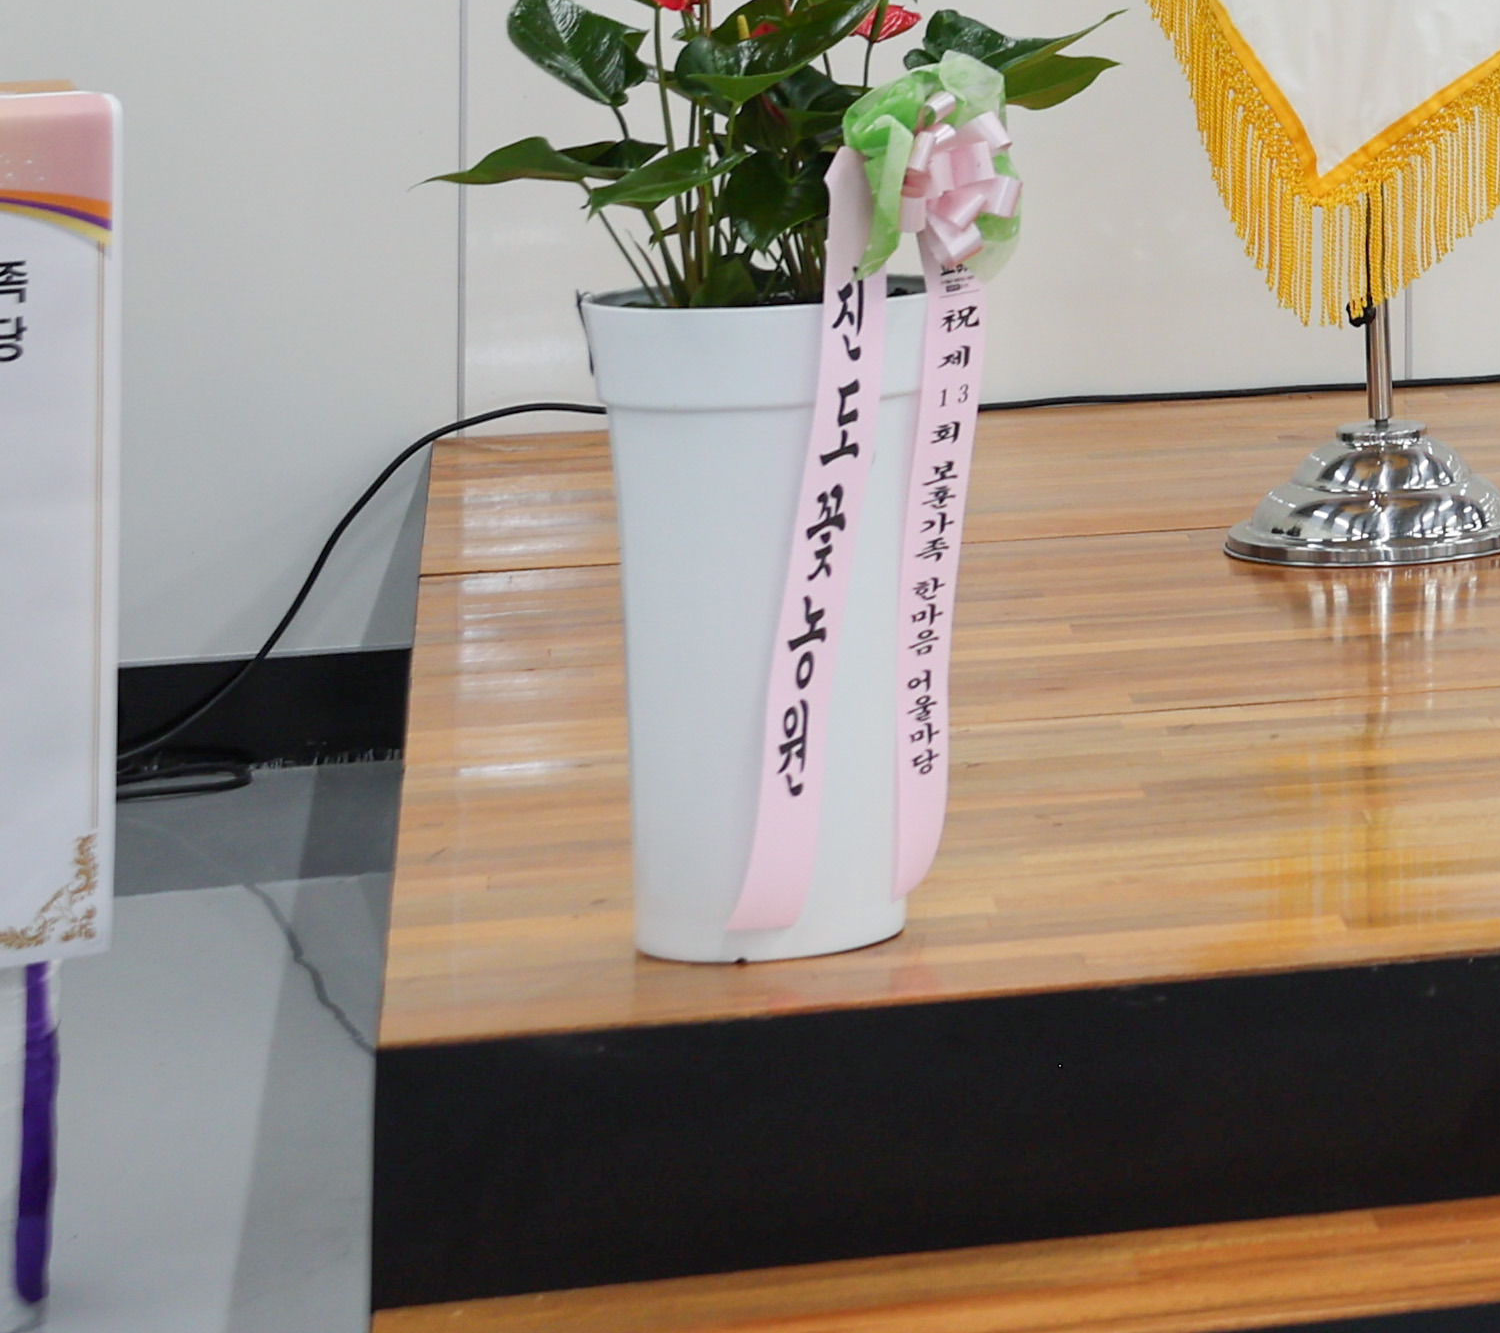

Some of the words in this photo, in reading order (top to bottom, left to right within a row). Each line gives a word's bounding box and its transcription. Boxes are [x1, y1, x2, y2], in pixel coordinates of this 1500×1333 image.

[940, 305, 980, 333] 祝
[914, 460, 960, 563] 보훈가족
[907, 576, 946, 657] 한마음
[906, 668, 942, 776] 어울마당
